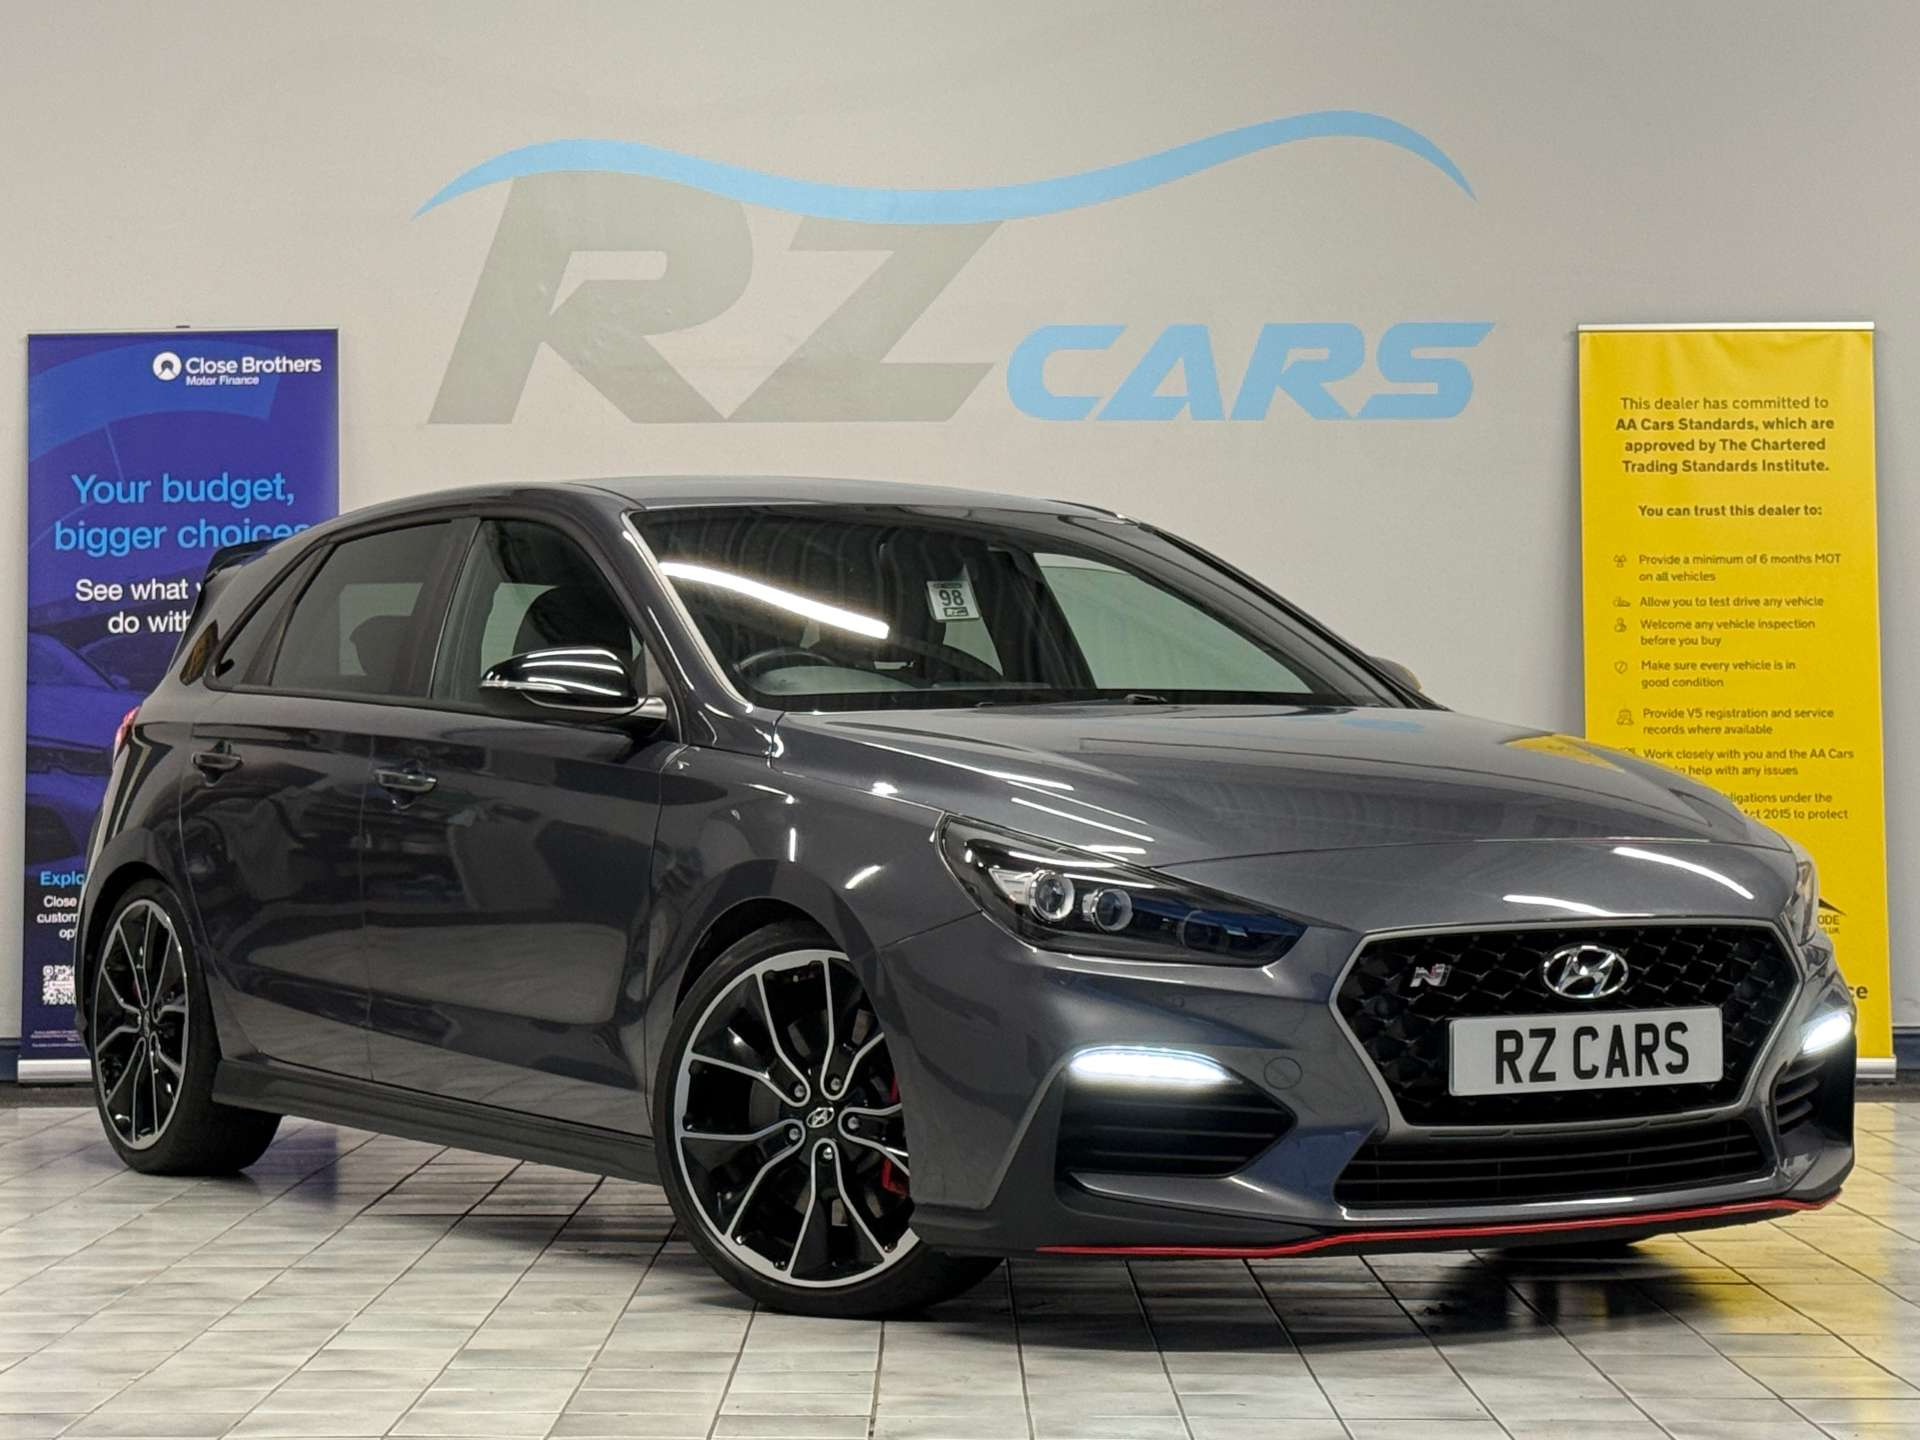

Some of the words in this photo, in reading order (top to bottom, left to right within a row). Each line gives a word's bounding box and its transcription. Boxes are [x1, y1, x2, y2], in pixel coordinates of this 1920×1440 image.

[427, 170, 1003, 424] RZ
[186, 357, 238, 374] Close
[242, 356, 322, 373] Brothers
[1006, 322, 1496, 421] CARS
[186, 376, 217, 386] Motor
[219, 375, 260, 385] Finance
[1620, 397, 1650, 411] This
[1654, 397, 1700, 411] dealer
[1703, 397, 1728, 411] has
[1732, 396, 1810, 410] committed
[1813, 396, 1829, 409] to
[1615, 419, 1638, 431] AA
[1641, 418, 1674, 431] Cars
[1678, 418, 1760, 431] Standards,
[1763, 417, 1807, 429] which
[1811, 419, 1835, 429] are
[1625, 439, 1695, 454] approved
[1698, 439, 1716, 454] by
[1719, 438, 1747, 451] The
[1751, 438, 1826, 451] Chartered
[1622, 460, 1678, 474] Trading
[1682, 460, 1758, 472] Standards
[1762, 459, 1829, 472] Institute.
[71, 474, 152, 504] Your
[162, 473, 295, 509] budget,
[1638, 505, 1663, 517] You
[1666, 507, 1690, 517] can
[1694, 505, 1726, 517] trust
[1730, 505, 1755, 517] this
[1758, 505, 1800, 517] dealer
[1803, 505, 1823, 516] to:
[54, 521, 167, 558] bigger
[1639, 554, 1681, 565] Provide
[1683, 556, 1690, 565] a
[1693, 554, 1744, 565] minimum
[1746, 554, 1757, 565] of
[1760, 554, 1767, 565] 6
[1770, 554, 1812, 565] months
[1814, 553, 1841, 564] MOT
[1639, 573, 1653, 582] on
[1656, 572, 1669, 582] all
[1671, 572, 1716, 582] vehicles
[75, 579, 123, 601] See
[130, 578, 189, 600] what
[939, 590, 965, 606] 98
[1639, 596, 1671, 607] Allow
[1672, 598, 1693, 608] you
[1695, 597, 1707, 607] to
[1709, 597, 1731, 607] test
[1733, 597, 1761, 607] drive
[1763, 598, 1783, 609] any
[1784, 596, 1824, 607] vehicle
[107, 612, 140, 633] do
[1640, 619, 1692, 630] Welcome
[1694, 621, 1714, 631] any
[1716, 619, 1755, 629] vehicle
[1758, 619, 1816, 631] inspection
[1640, 635, 1677, 646] before
[1679, 637, 1699, 648] you
[1701, 635, 1722, 647] buy
[1641, 660, 1671, 671] Make
[1673, 662, 1697, 671] sure
[1700, 662, 1730, 673] every
[1731, 660, 1772, 670] vehicle
[1774, 660, 1784, 670] is
[1785, 660, 1796, 670] in
[1641, 677, 1669, 690] good
[1672, 677, 1724, 688] condition
[1643, 708, 1684, 719] Provide
[1705, 708, 1768, 720] registration
[1770, 708, 1792, 718] and
[1794, 708, 1834, 718] service
[1643, 725, 1685, 735] records
[1687, 725, 1722, 735] where
[1724, 724, 1773, 735] available
[1643, 748, 1674, 759] Work
[1676, 748, 1714, 761] closely
[1716, 748, 1741, 759] with
[1743, 751, 1764, 761] you
[1766, 748, 1786, 759] and
[1788, 748, 1807, 759] the
[1809, 747, 1827, 758] AA
[1829, 748, 1855, 758] Cars
[1688, 765, 1712, 776] help
[1714, 765, 1740, 776] with
[1742, 767, 1762, 777] any
[1764, 765, 1799, 776] issues
[1780, 792, 1808, 803] under
[1814, 792, 1832, 803] the
[1764, 808, 1791, 819] 2015
[1794, 809, 1805, 819] to
[1808, 808, 1848, 821] protect
[43, 895, 78, 908] Close
[1495, 1028, 1556, 1084] RZ
[1572, 1021, 1689, 1080] CARS
